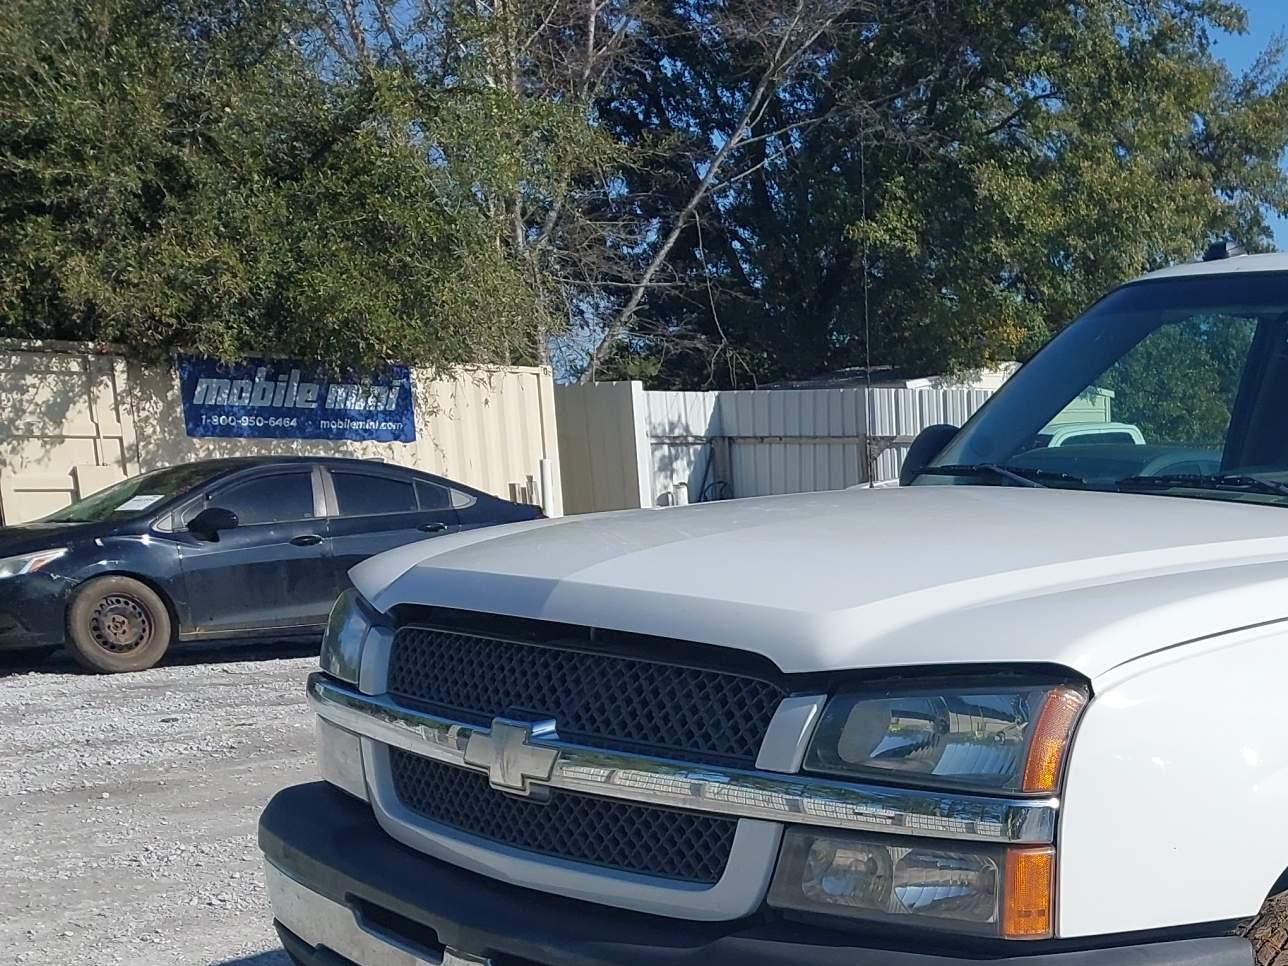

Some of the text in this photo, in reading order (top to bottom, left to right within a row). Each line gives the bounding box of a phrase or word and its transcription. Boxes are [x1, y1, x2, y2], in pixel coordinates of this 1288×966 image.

[193, 367, 401, 411] mobile mini
[201, 415, 403, 430] 1-800-950-6464 mobilemini.com
